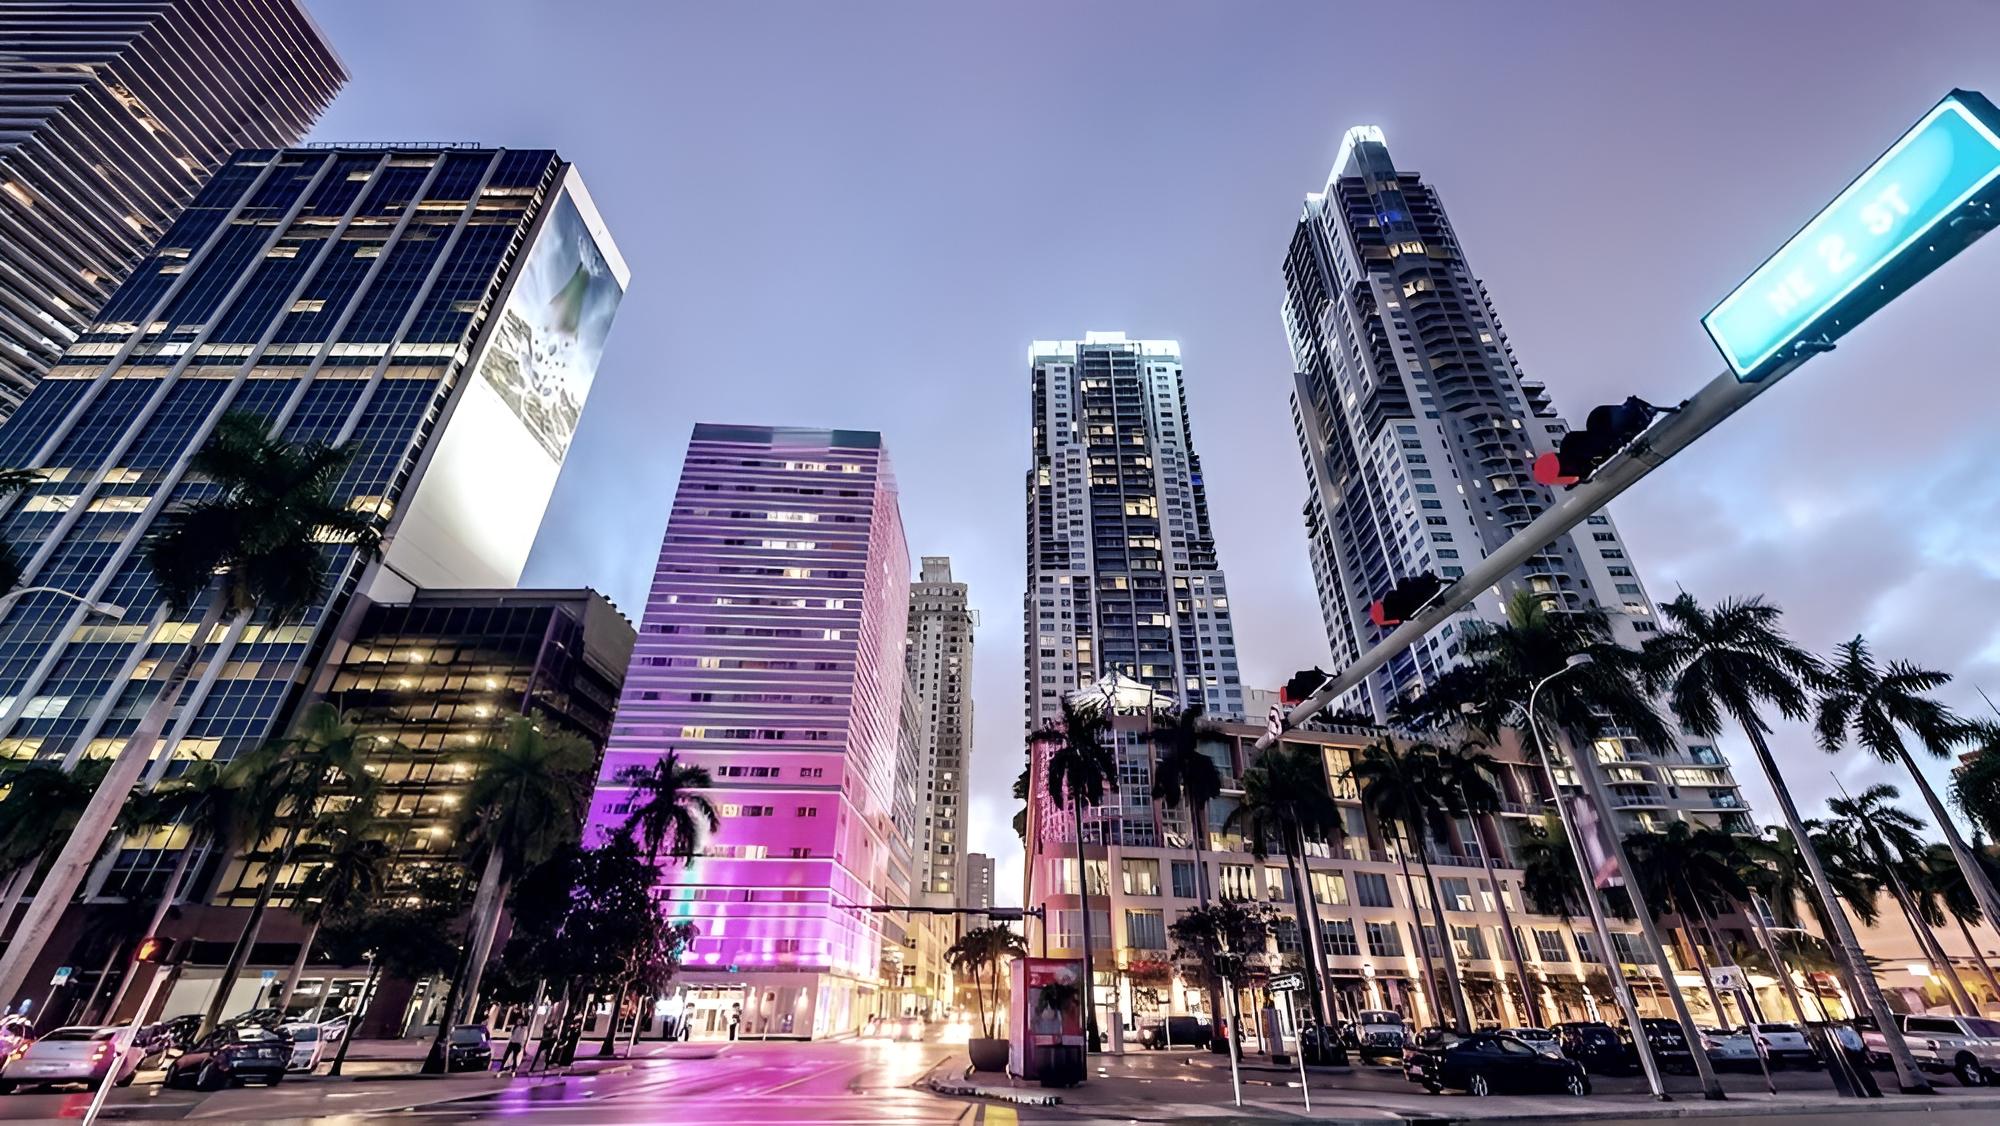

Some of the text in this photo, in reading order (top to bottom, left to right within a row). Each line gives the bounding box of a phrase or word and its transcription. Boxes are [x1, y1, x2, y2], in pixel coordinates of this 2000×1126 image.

[1768, 183, 1909, 315] NE 2 ST
